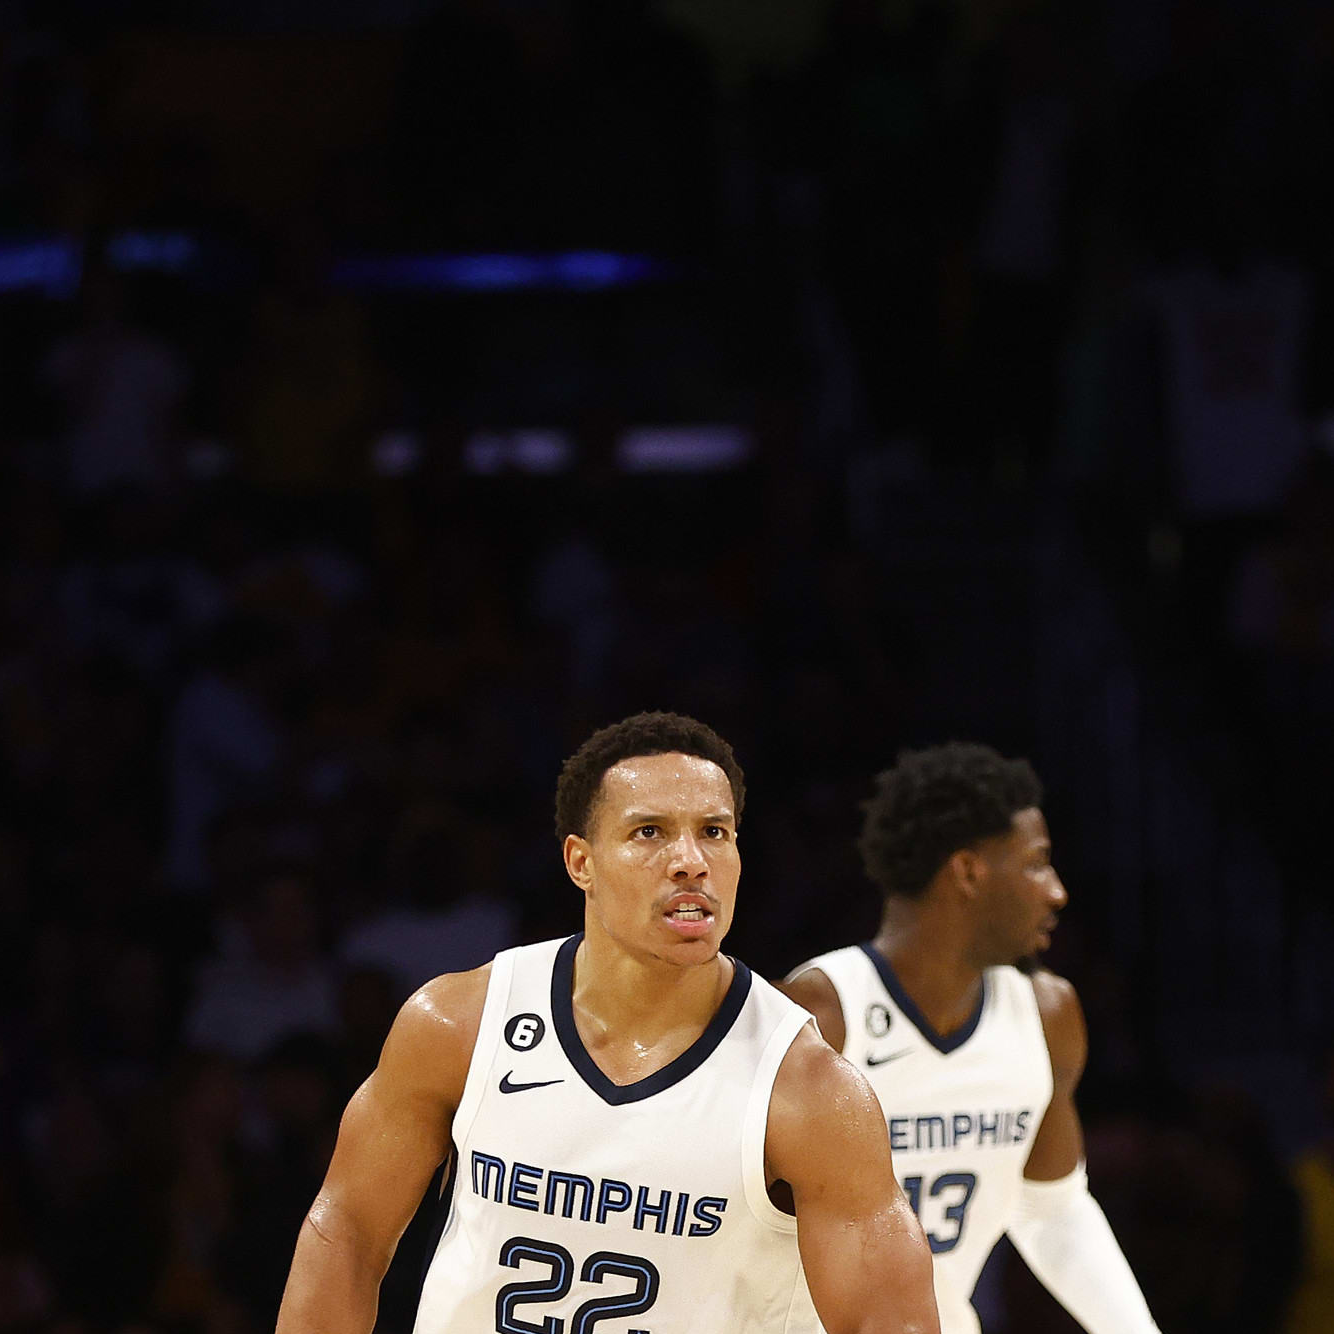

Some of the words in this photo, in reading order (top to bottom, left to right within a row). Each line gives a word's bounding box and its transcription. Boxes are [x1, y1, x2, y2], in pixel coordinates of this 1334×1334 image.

[510, 1017, 539, 1048] 6
[887, 1109, 1031, 1152] EMPHIS
[471, 1149, 729, 1238] MEMPHIS
[902, 1171, 978, 1254] 13
